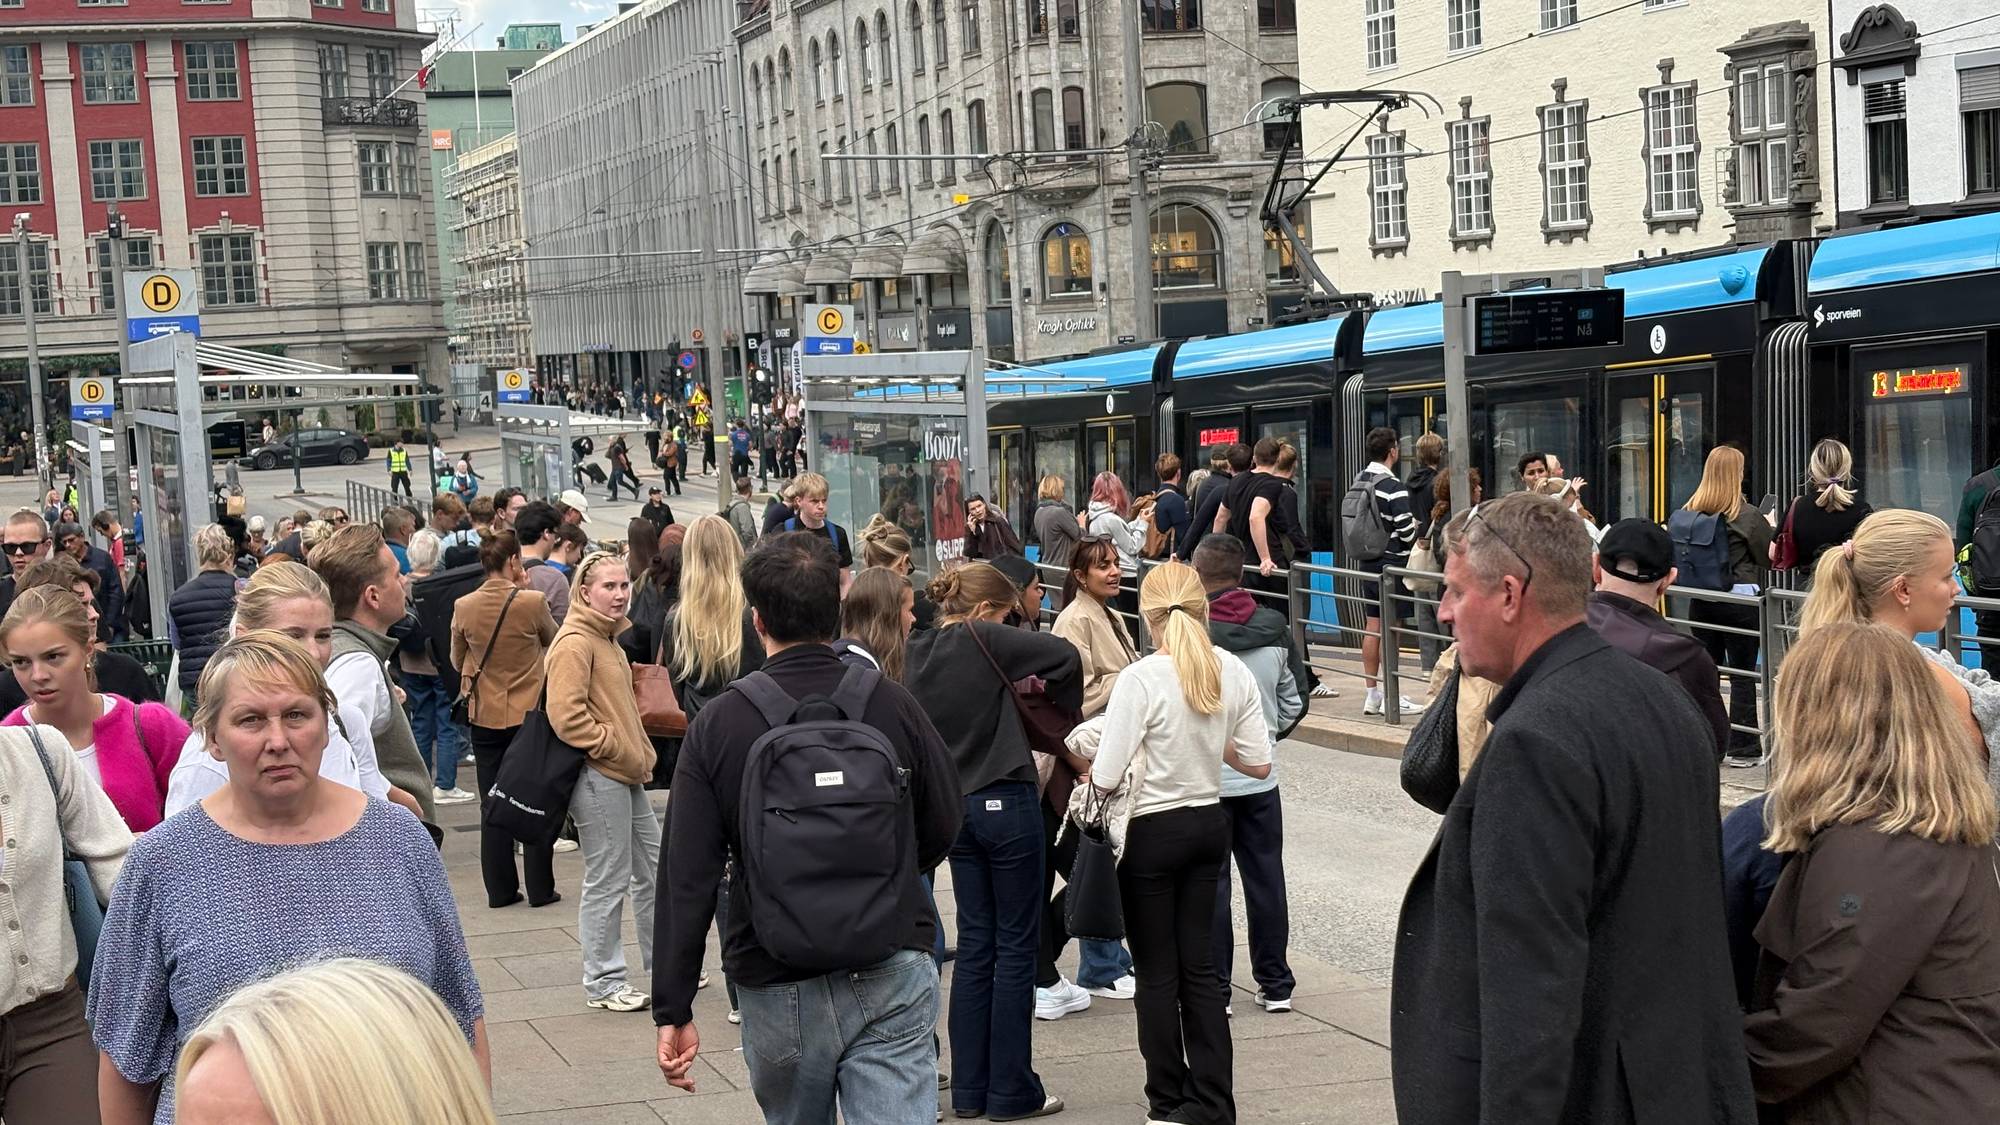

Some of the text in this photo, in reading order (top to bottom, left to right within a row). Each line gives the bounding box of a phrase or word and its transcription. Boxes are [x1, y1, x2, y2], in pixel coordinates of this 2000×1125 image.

[153, 282, 171, 305] D
[824, 312, 836, 329] C
[1826, 308, 1861, 323] sporveien
[1037, 317, 1096, 335] Krogh Optikk
[509, 374, 518, 387] C
[88, 384, 99, 399] D
[481, 395, 491, 409] 4
